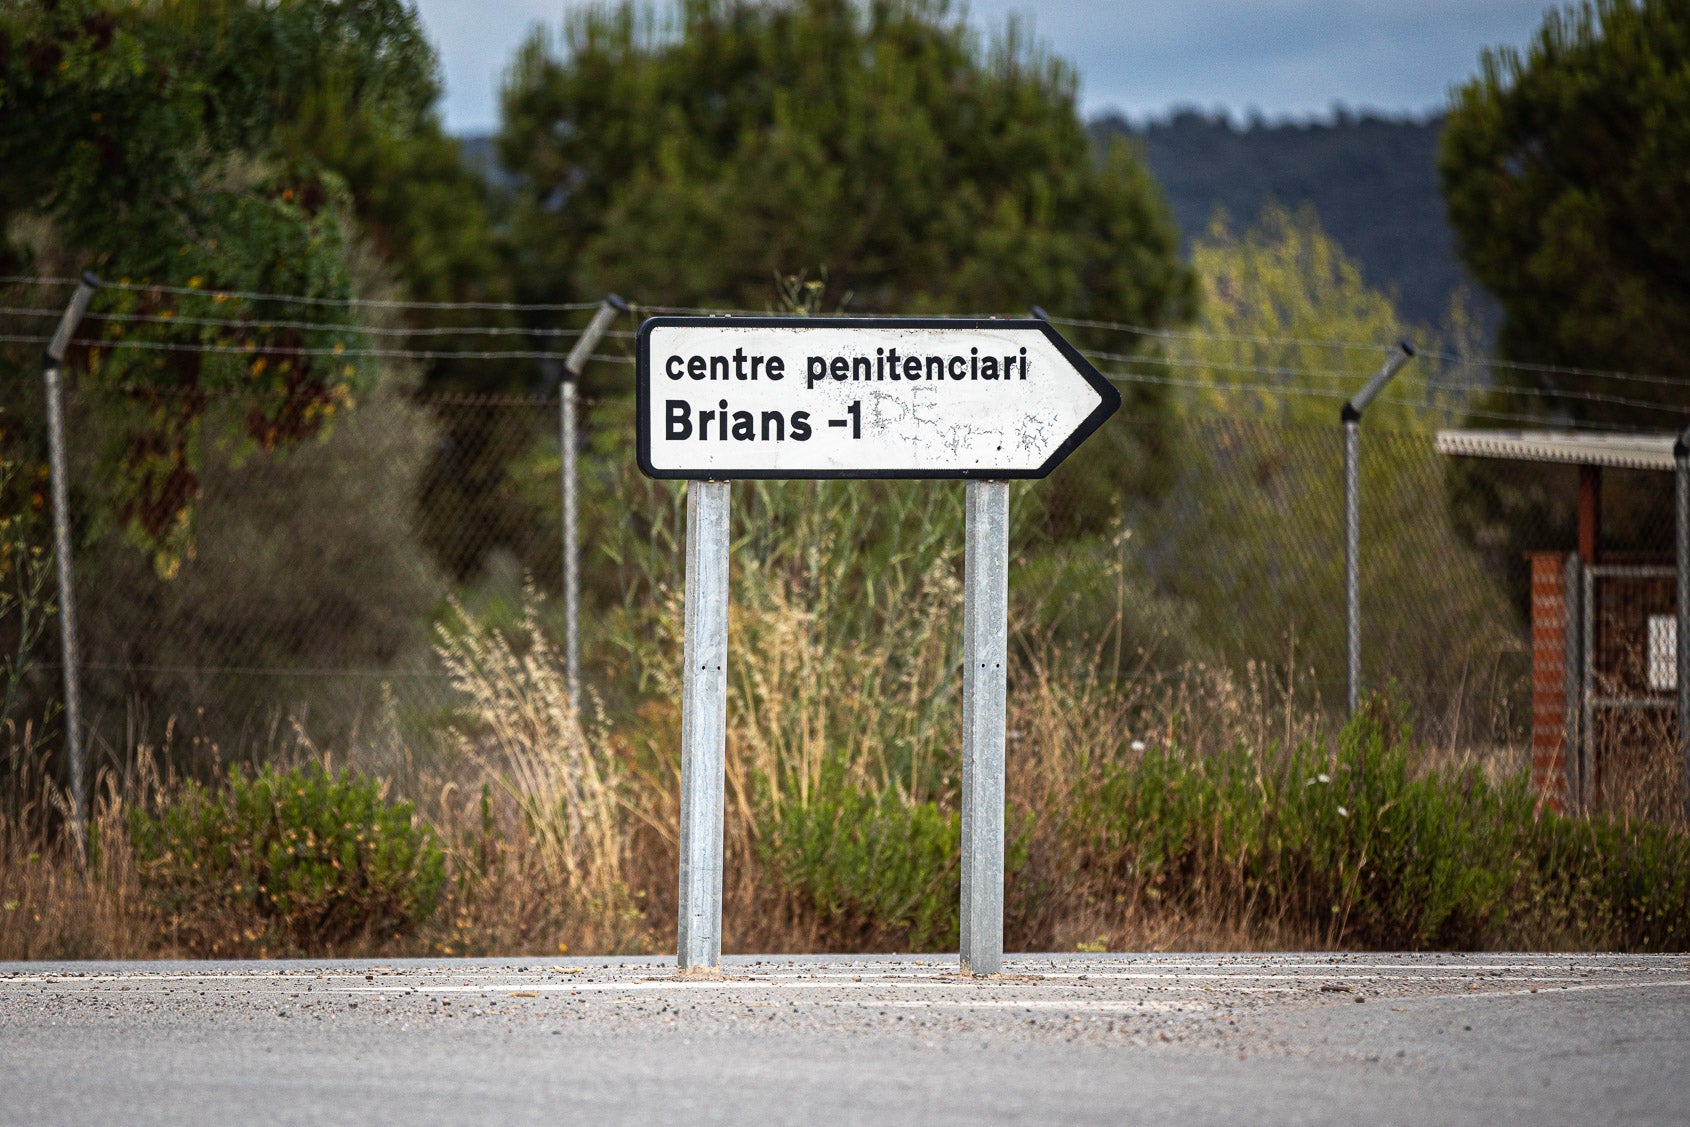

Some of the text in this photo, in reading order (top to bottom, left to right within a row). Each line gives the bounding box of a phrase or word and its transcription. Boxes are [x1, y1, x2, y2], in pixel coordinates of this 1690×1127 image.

[665, 346, 1028, 389] centre penitenciari
[665, 398, 812, 442] Brians
[828, 400, 861, 440] -1
